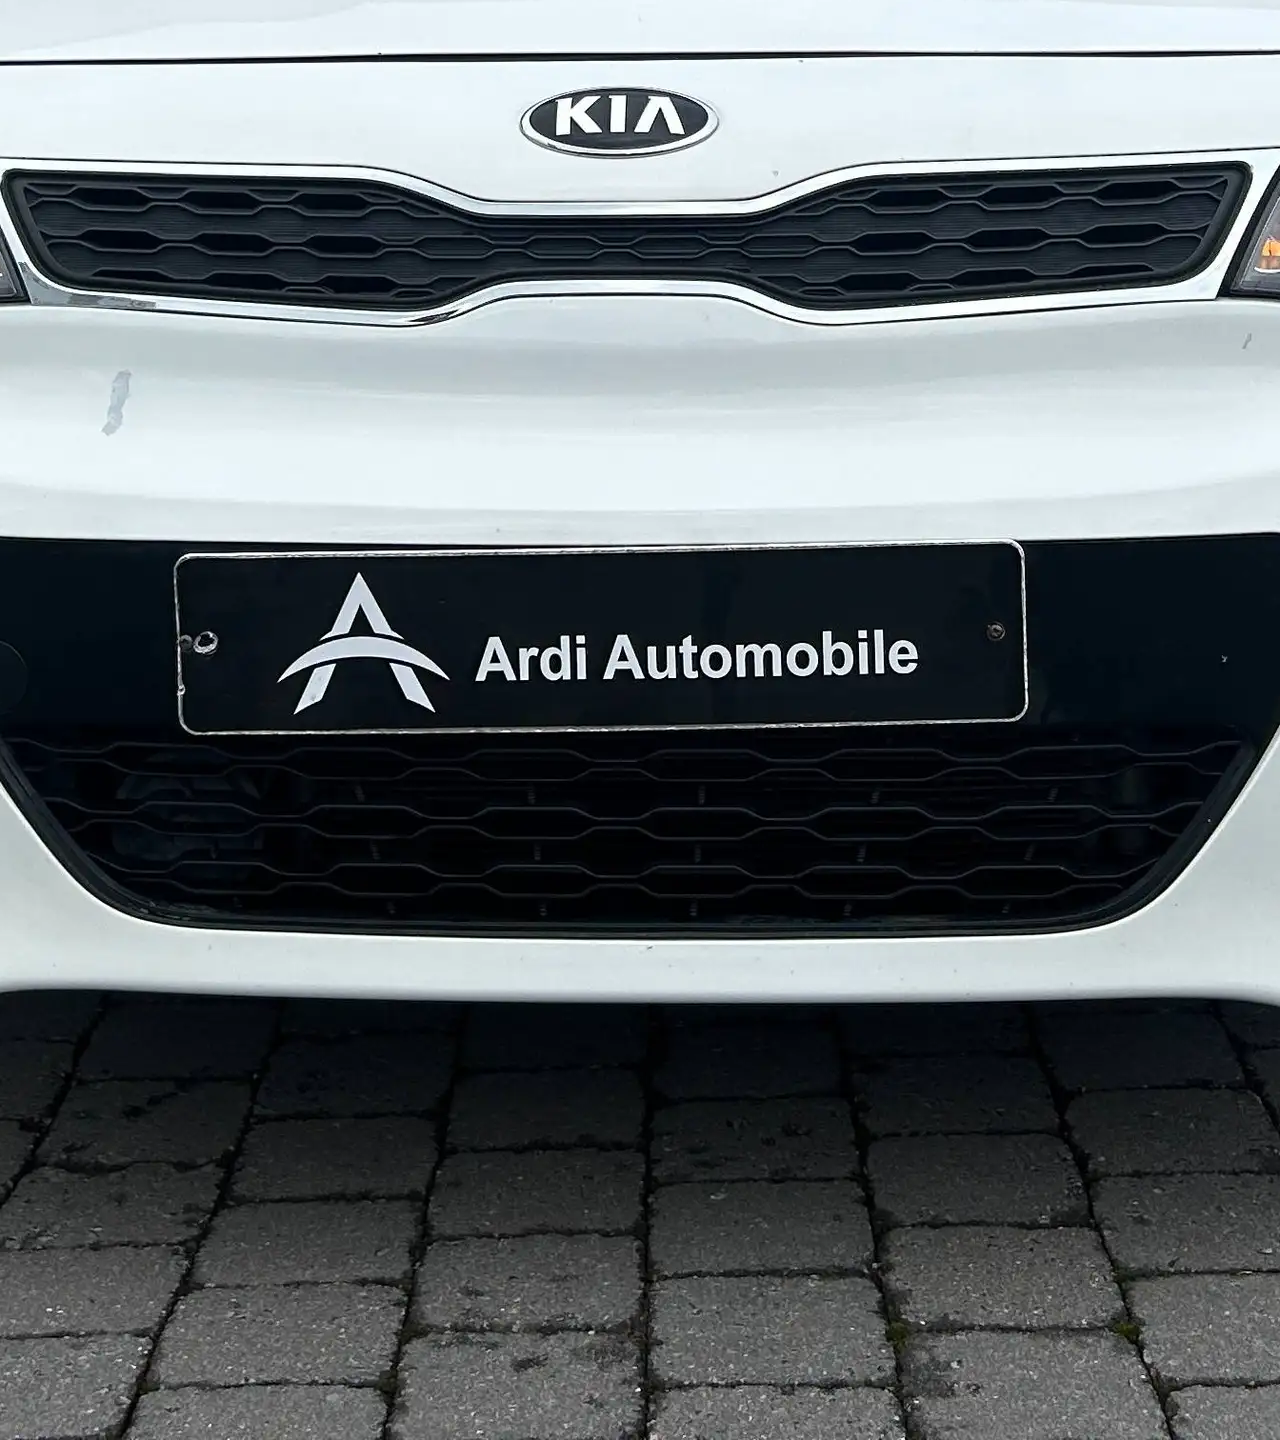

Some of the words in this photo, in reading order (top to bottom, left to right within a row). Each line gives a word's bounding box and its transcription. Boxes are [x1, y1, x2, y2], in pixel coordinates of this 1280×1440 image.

[555, 94, 686, 137] KIA
[475, 634, 587, 682] Ardi
[602, 629, 919, 680] Automobile
